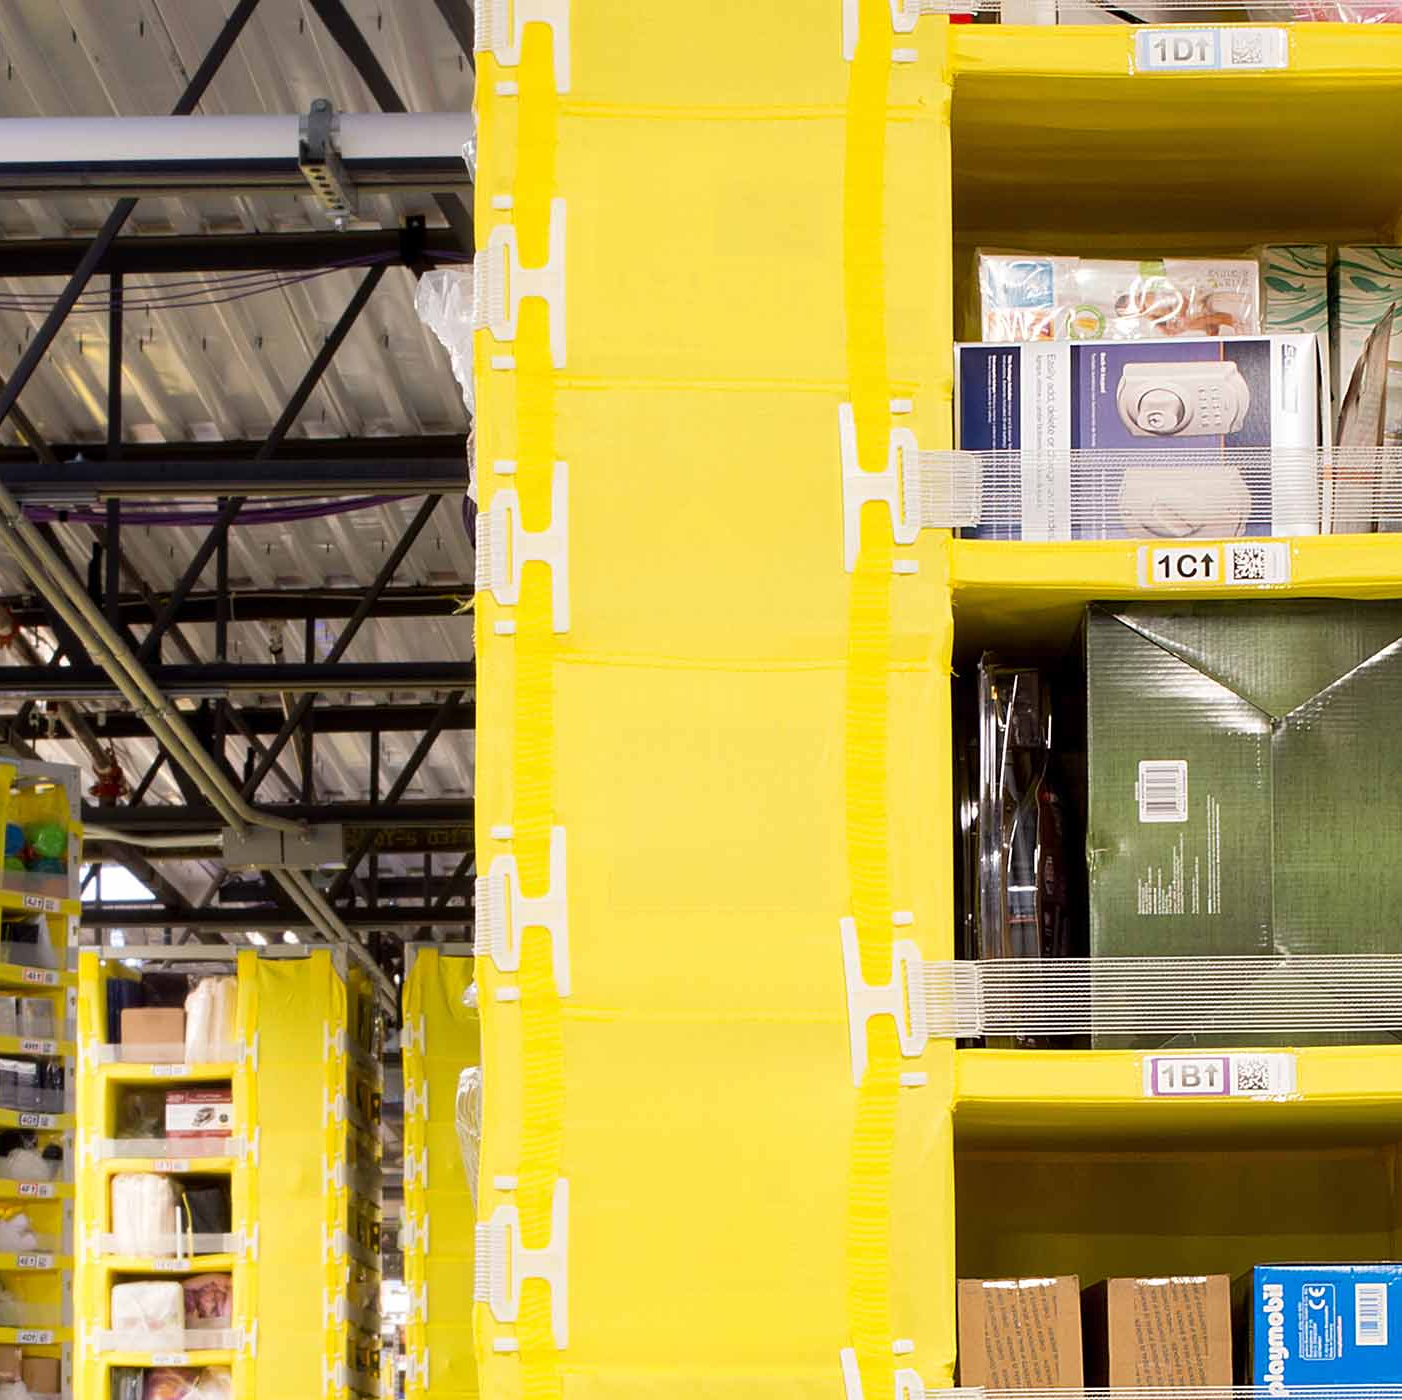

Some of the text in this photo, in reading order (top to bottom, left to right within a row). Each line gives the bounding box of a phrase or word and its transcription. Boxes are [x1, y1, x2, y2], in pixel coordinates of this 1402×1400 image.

[1154, 38, 1193, 61] 1D
[1158, 554, 1197, 578] 1C
[1162, 1065, 1201, 1088] 1B
[1263, 1284, 1290, 1397] playmobil
